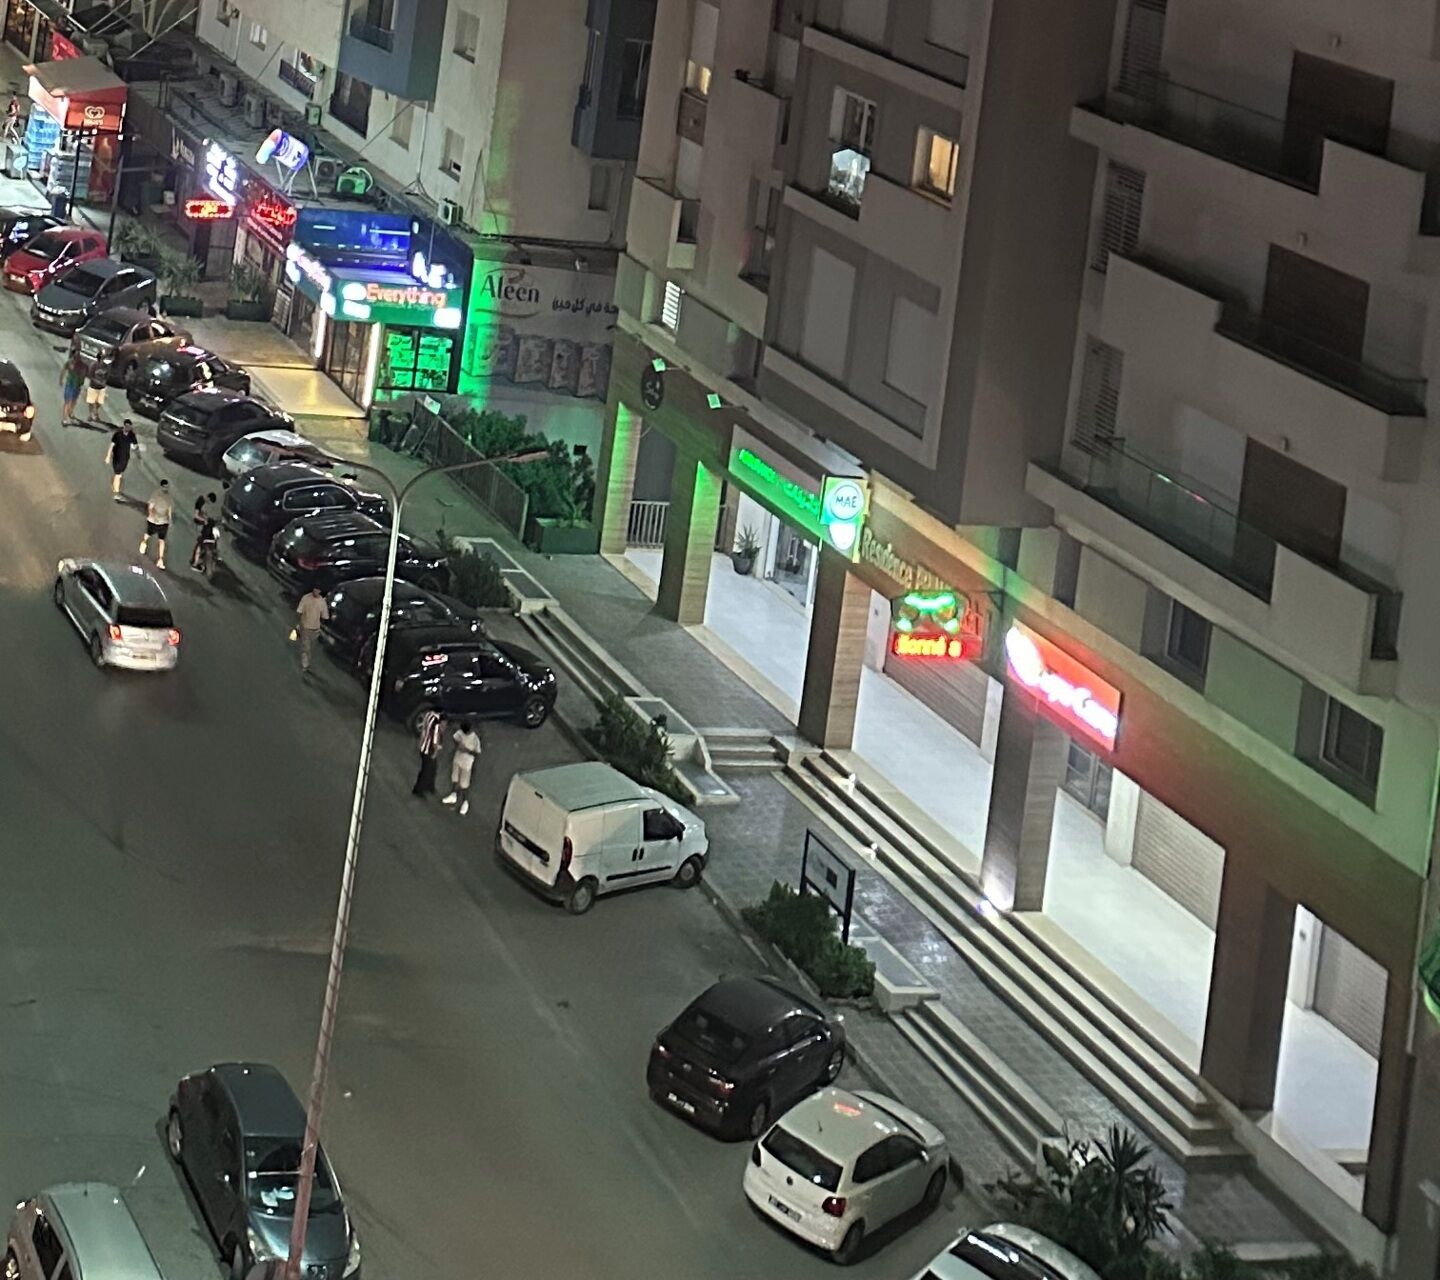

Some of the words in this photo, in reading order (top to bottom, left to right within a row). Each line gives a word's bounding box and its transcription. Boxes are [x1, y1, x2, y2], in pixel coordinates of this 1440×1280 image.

[367, 283, 447, 309] Everything
[480, 274, 540, 303] Aleen
[835, 495, 858, 509] MAE
